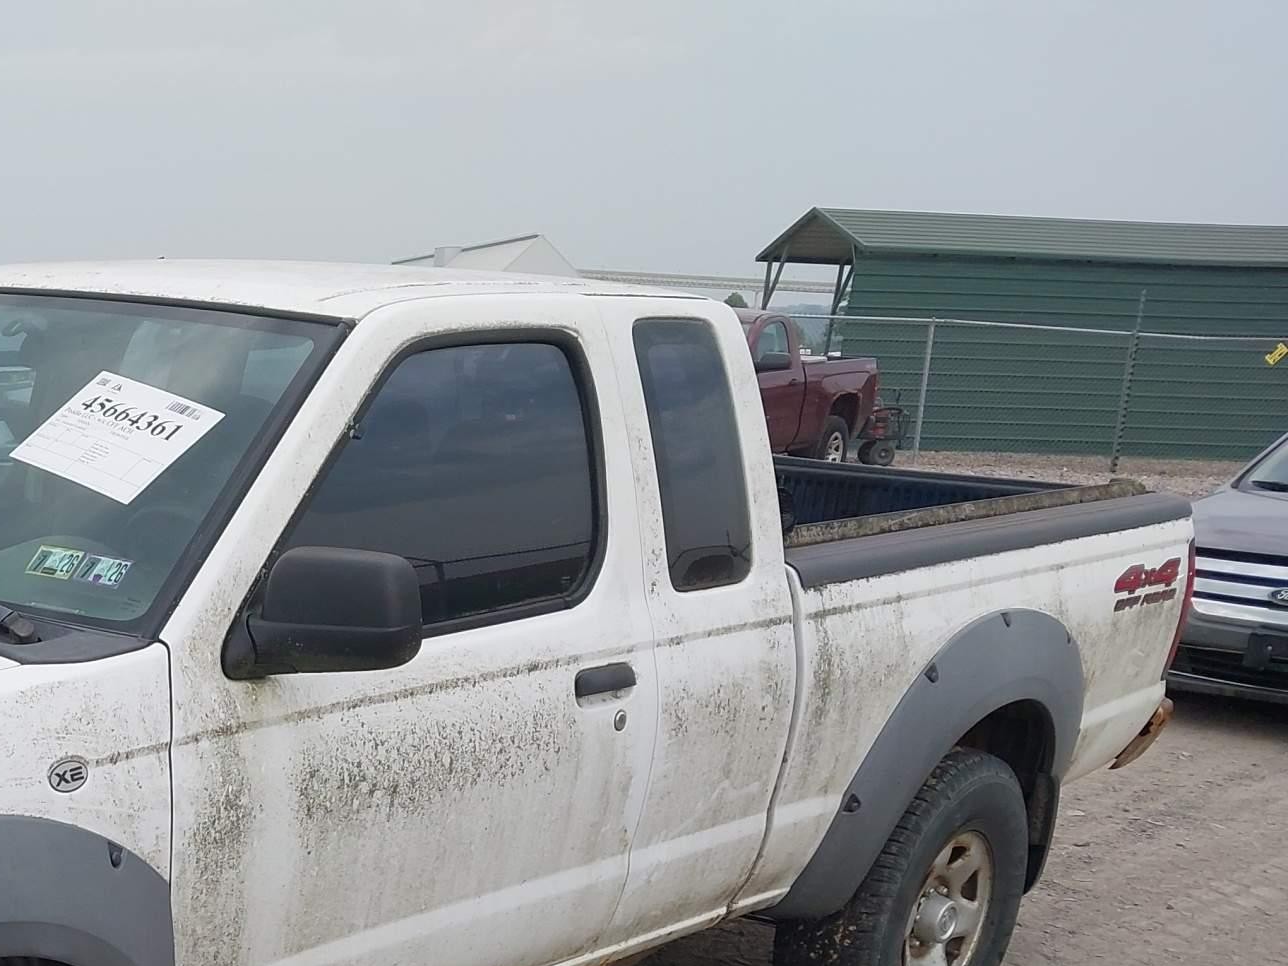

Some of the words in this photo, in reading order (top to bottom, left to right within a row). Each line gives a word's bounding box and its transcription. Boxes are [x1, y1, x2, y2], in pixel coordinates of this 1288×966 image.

[81, 395, 184, 441] 45664361
[1114, 557, 1181, 595] 4x4
[54, 765, 85, 788] XE
